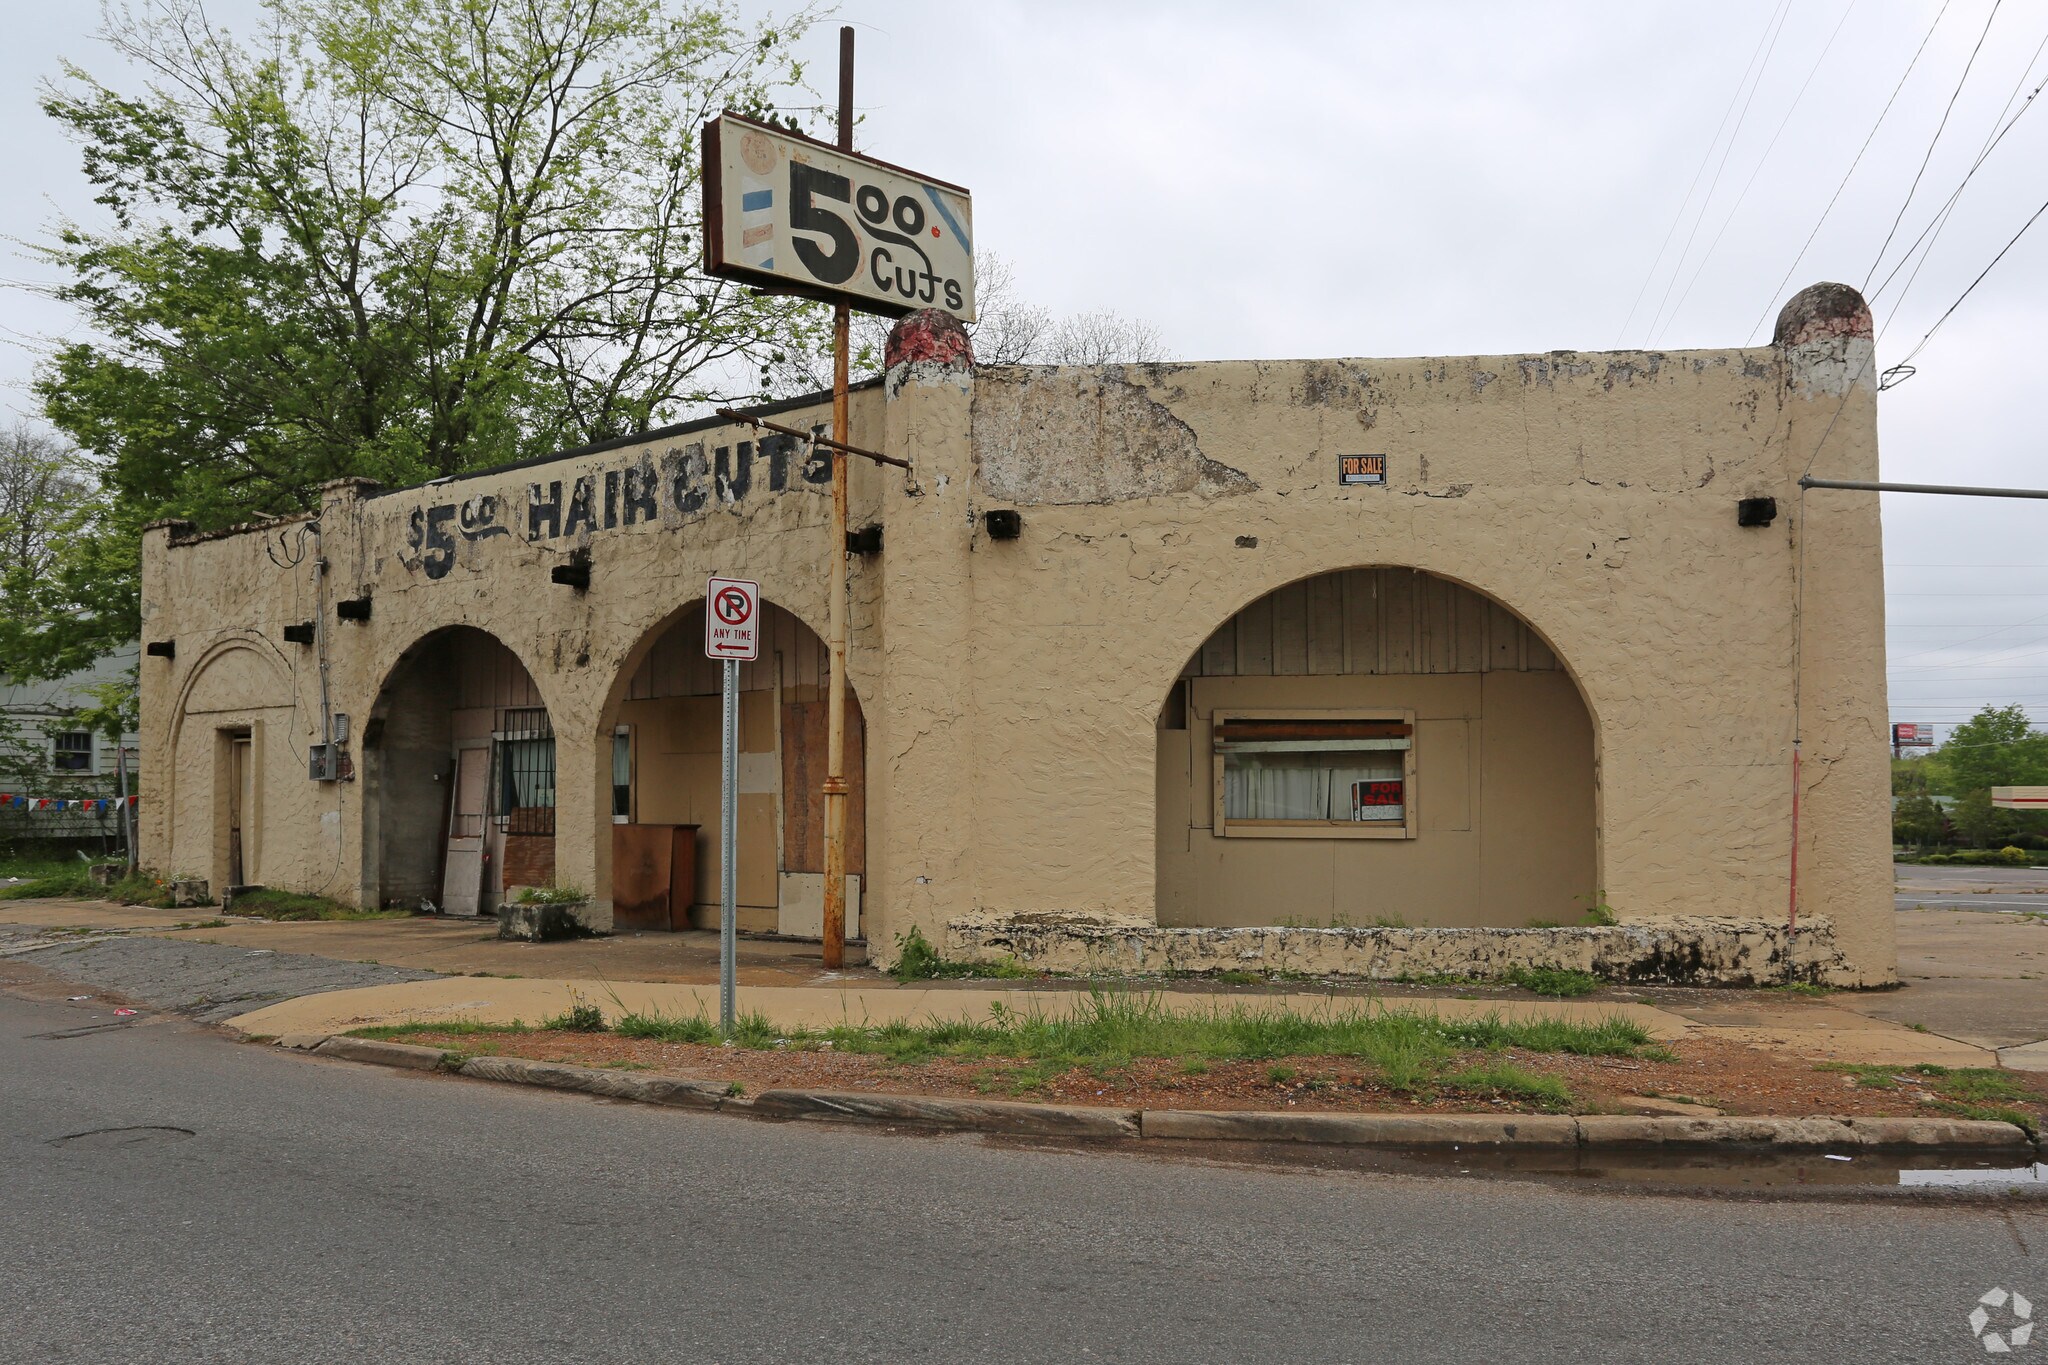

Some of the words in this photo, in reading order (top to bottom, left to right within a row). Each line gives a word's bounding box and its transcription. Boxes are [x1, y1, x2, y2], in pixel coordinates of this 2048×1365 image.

[1342, 458, 1360, 475] FOR
[1361, 457, 1383, 474] SALE
[713, 628, 731, 639] ANY
[734, 629, 752, 641] TIME
[1370, 782, 1401, 794] FOR
[1363, 794, 1403, 805] SAL
